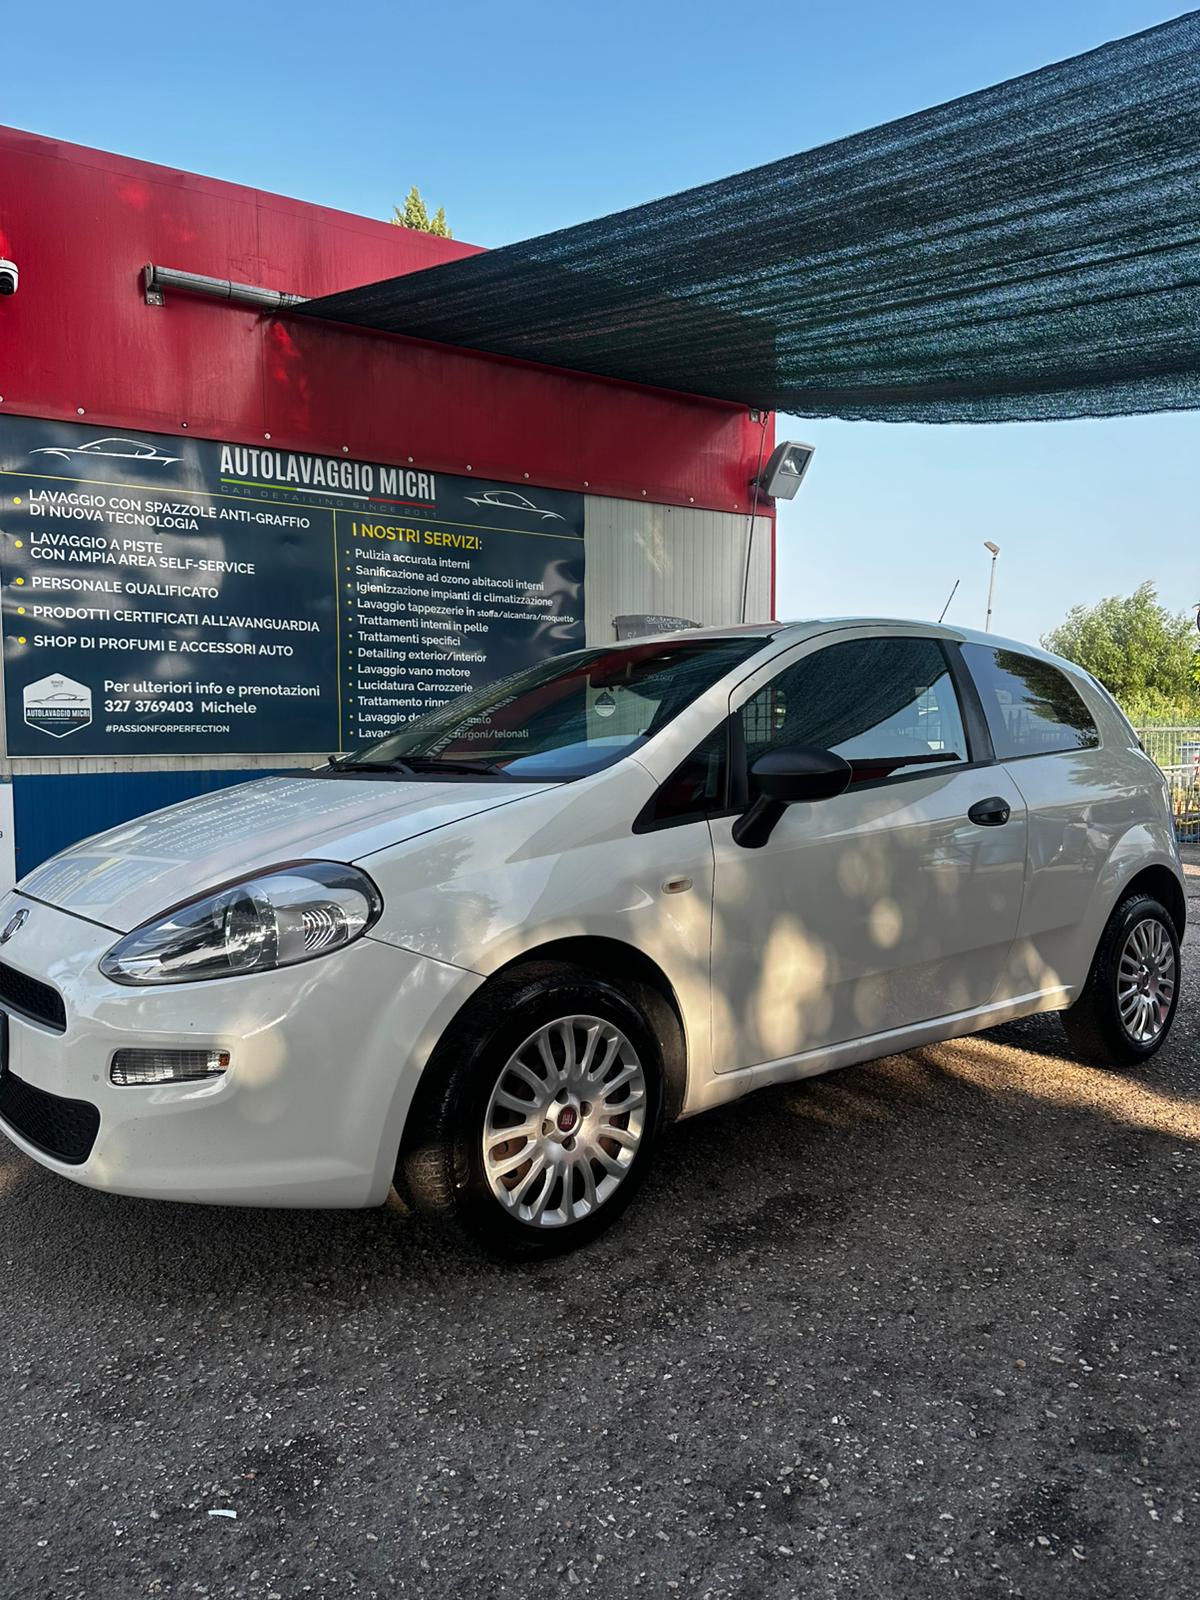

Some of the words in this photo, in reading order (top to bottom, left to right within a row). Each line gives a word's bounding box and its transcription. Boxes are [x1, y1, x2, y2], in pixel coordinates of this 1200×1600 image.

[220, 445, 374, 492] AUTOLAVAGGIO
[380, 468, 436, 500] MICRI
[29, 489, 105, 507] LAVAGGIO
[109, 498, 142, 511] CON
[145, 501, 216, 518] SPAZZOLE
[220, 509, 310, 528] ANTI-GRAFFIO
[221, 485, 251, 495] CAR
[261, 491, 344, 506] DETAILING
[353, 502, 398, 513] SINCE
[404, 508, 437, 518] 2011
[30, 504, 46, 516] DI
[49, 506, 104, 522] NUOVA
[106, 511, 198, 530] TECNOLOGIA
[30, 532, 107, 549] LAVAGGIO
[110, 539, 120, 551] A
[124, 540, 163, 554] PISTE
[352, 522, 357, 537] I
[361, 524, 420, 544] NOSTRI
[424, 532, 482, 551] SERVIZI:
[31, 548, 65, 561] CON
[69, 551, 116, 564] AMPIA
[119, 553, 156, 567] AREA
[159, 556, 255, 574] SELF-SERVICE
[355, 549, 391, 562] Pulizia
[393, 553, 437, 566] accurata
[438, 557, 470, 569] interni
[32, 576, 122, 593] PERSONALE
[126, 583, 219, 599] QUALIFICATO
[355, 565, 424, 581] Sanificazione
[426, 572, 439, 583] ad
[441, 575, 470, 586] ozono
[472, 576, 513, 588] abitacoli
[515, 580, 544, 591] interni
[356, 582, 429, 598] Igienizzazione
[431, 589, 470, 602] impianti
[472, 592, 482, 602] di
[484, 592, 553, 607] climatizzazione
[33, 606, 110, 621] PRODOTTI
[114, 610, 198, 626] CERTIFICATI
[202, 614, 320, 632] ALL'AVANGUARDIA
[357, 598, 406, 613] Lavaggio
[408, 603, 464, 618] tappezzerie
[466, 606, 475, 616] in
[477, 610, 574, 624] stoffa/alcantara/moquette
[358, 614, 419, 628] Trattamenti
[420, 619, 452, 631] interni
[453, 620, 462, 631] in
[463, 622, 489, 633] pelle
[34, 635, 77, 649] SHOP
[81, 637, 95, 649] DI
[99, 638, 165, 652] PROFUMI
[169, 640, 177, 652] E
[180, 641, 256, 655] ACCESSORI
[259, 644, 294, 657] AUTO
[358, 631, 419, 644] Trattamenti
[421, 636, 461, 647] specifici
[358, 648, 406, 662] Detailing
[408, 651, 487, 663] exterior/interior
[358, 664, 406, 678] Lavaggio
[408, 668, 434, 676] vano
[435, 667, 470, 678] motore
[104, 680, 129, 693] Per
[133, 680, 192, 694] ulteriori
[196, 682, 222, 694] info
[226, 686, 235, 695] e
[239, 684, 320, 699] prenotazioni
[358, 680, 414, 691] Lucidatura
[417, 681, 473, 693] Carrozzerie
[105, 700, 130, 713] 327
[136, 700, 194, 713] 3769403
[201, 700, 257, 714] Michele
[358, 696, 423, 707] Trattamento
[26, 709, 71, 717] AUTOLAVAGGIO
[72, 709, 90, 718] MICRI
[358, 712, 406, 726] Lavaggio
[105, 724, 230, 733] #PASSIONFORPERFECTION
